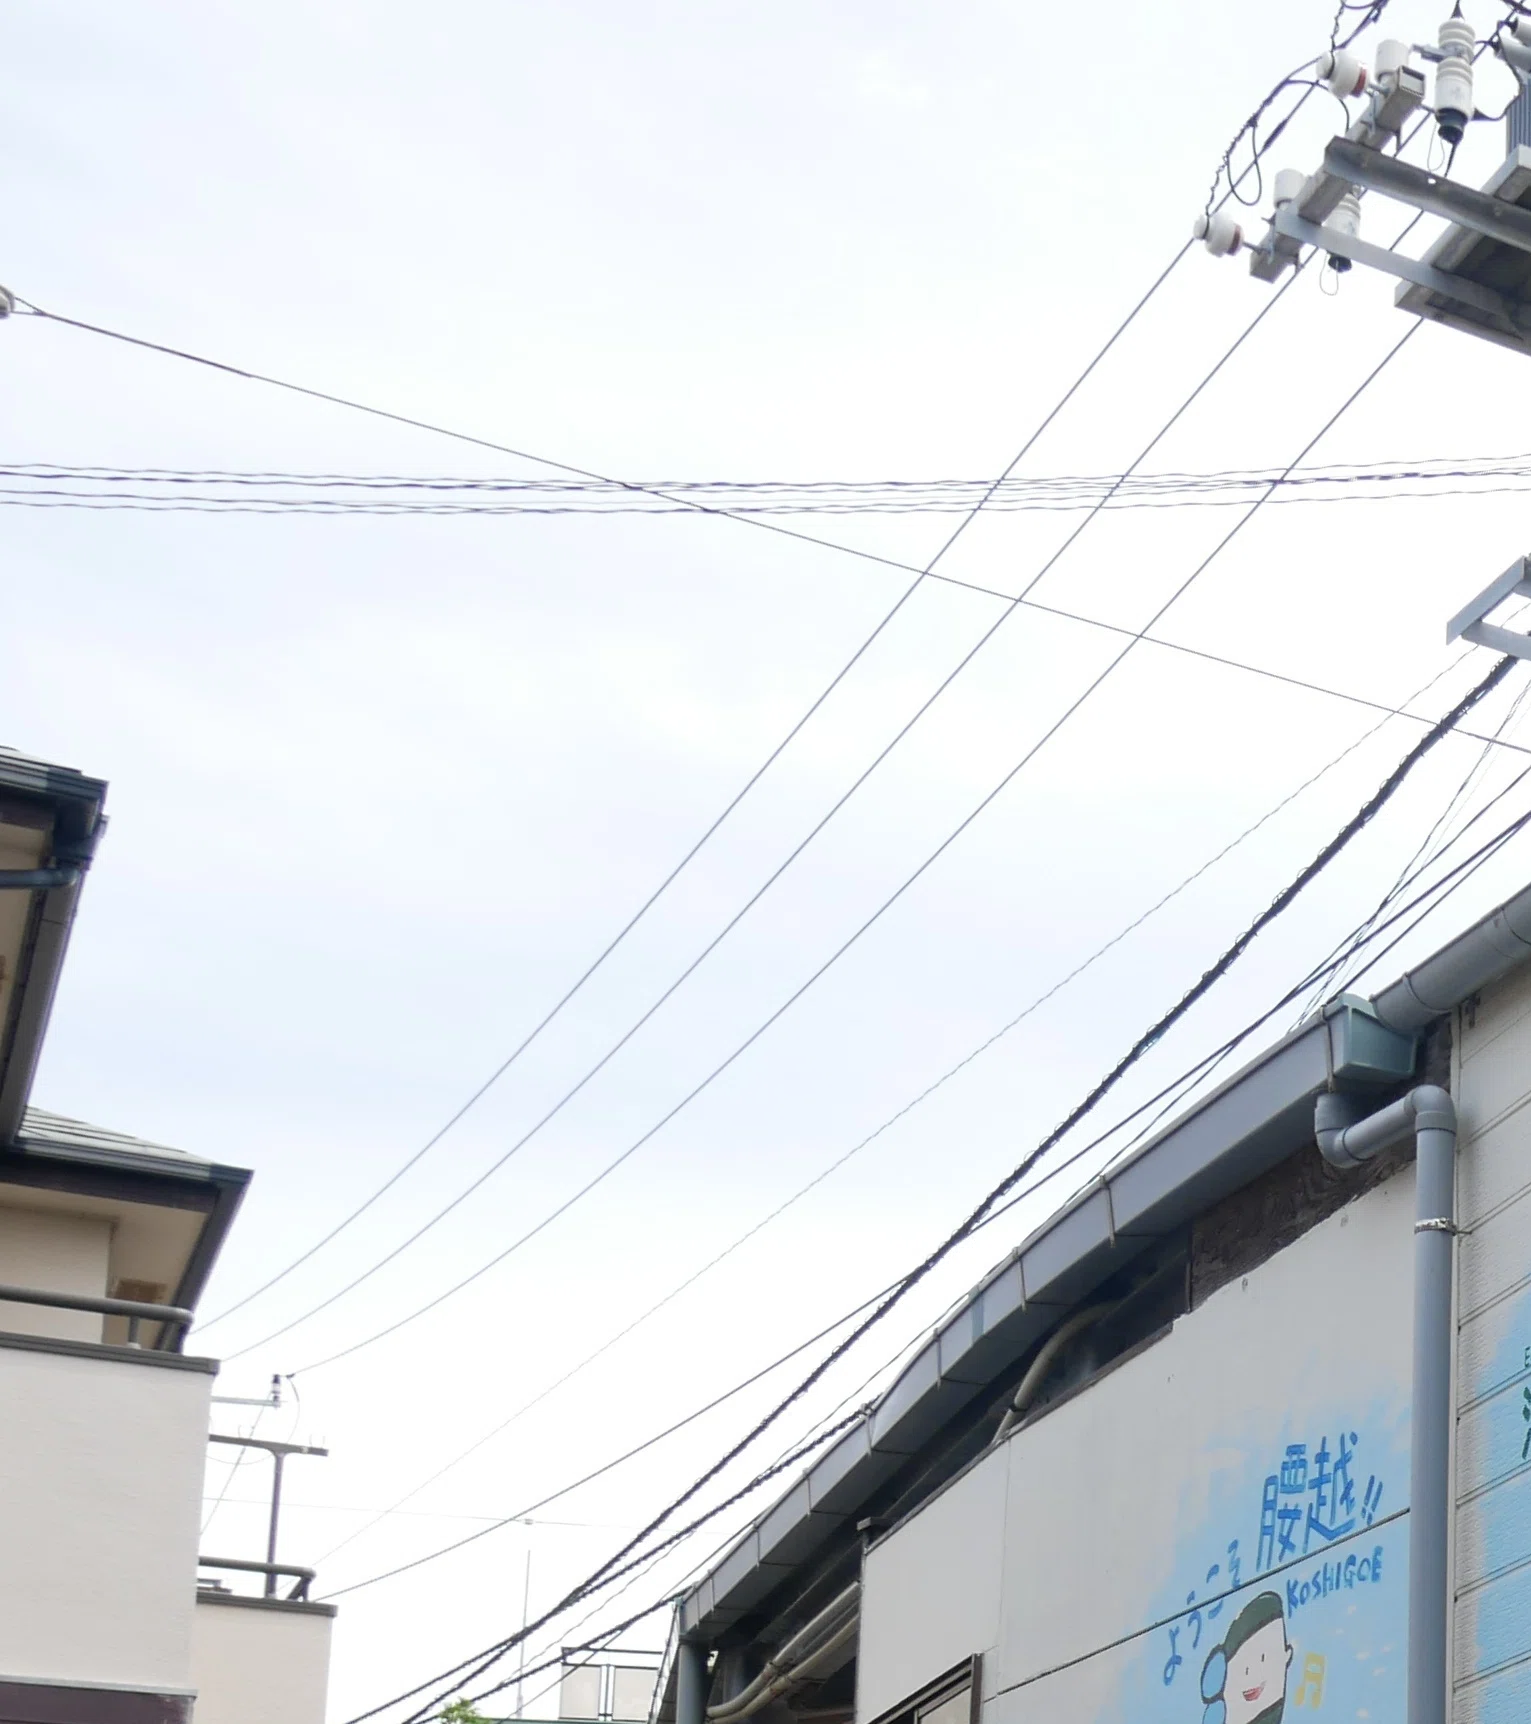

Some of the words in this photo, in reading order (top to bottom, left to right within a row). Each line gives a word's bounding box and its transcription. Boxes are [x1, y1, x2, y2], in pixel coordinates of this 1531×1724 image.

[1163, 1538, 1241, 1686] ようこそ
[1285, 1546, 1384, 1619] KOSHIGOE
